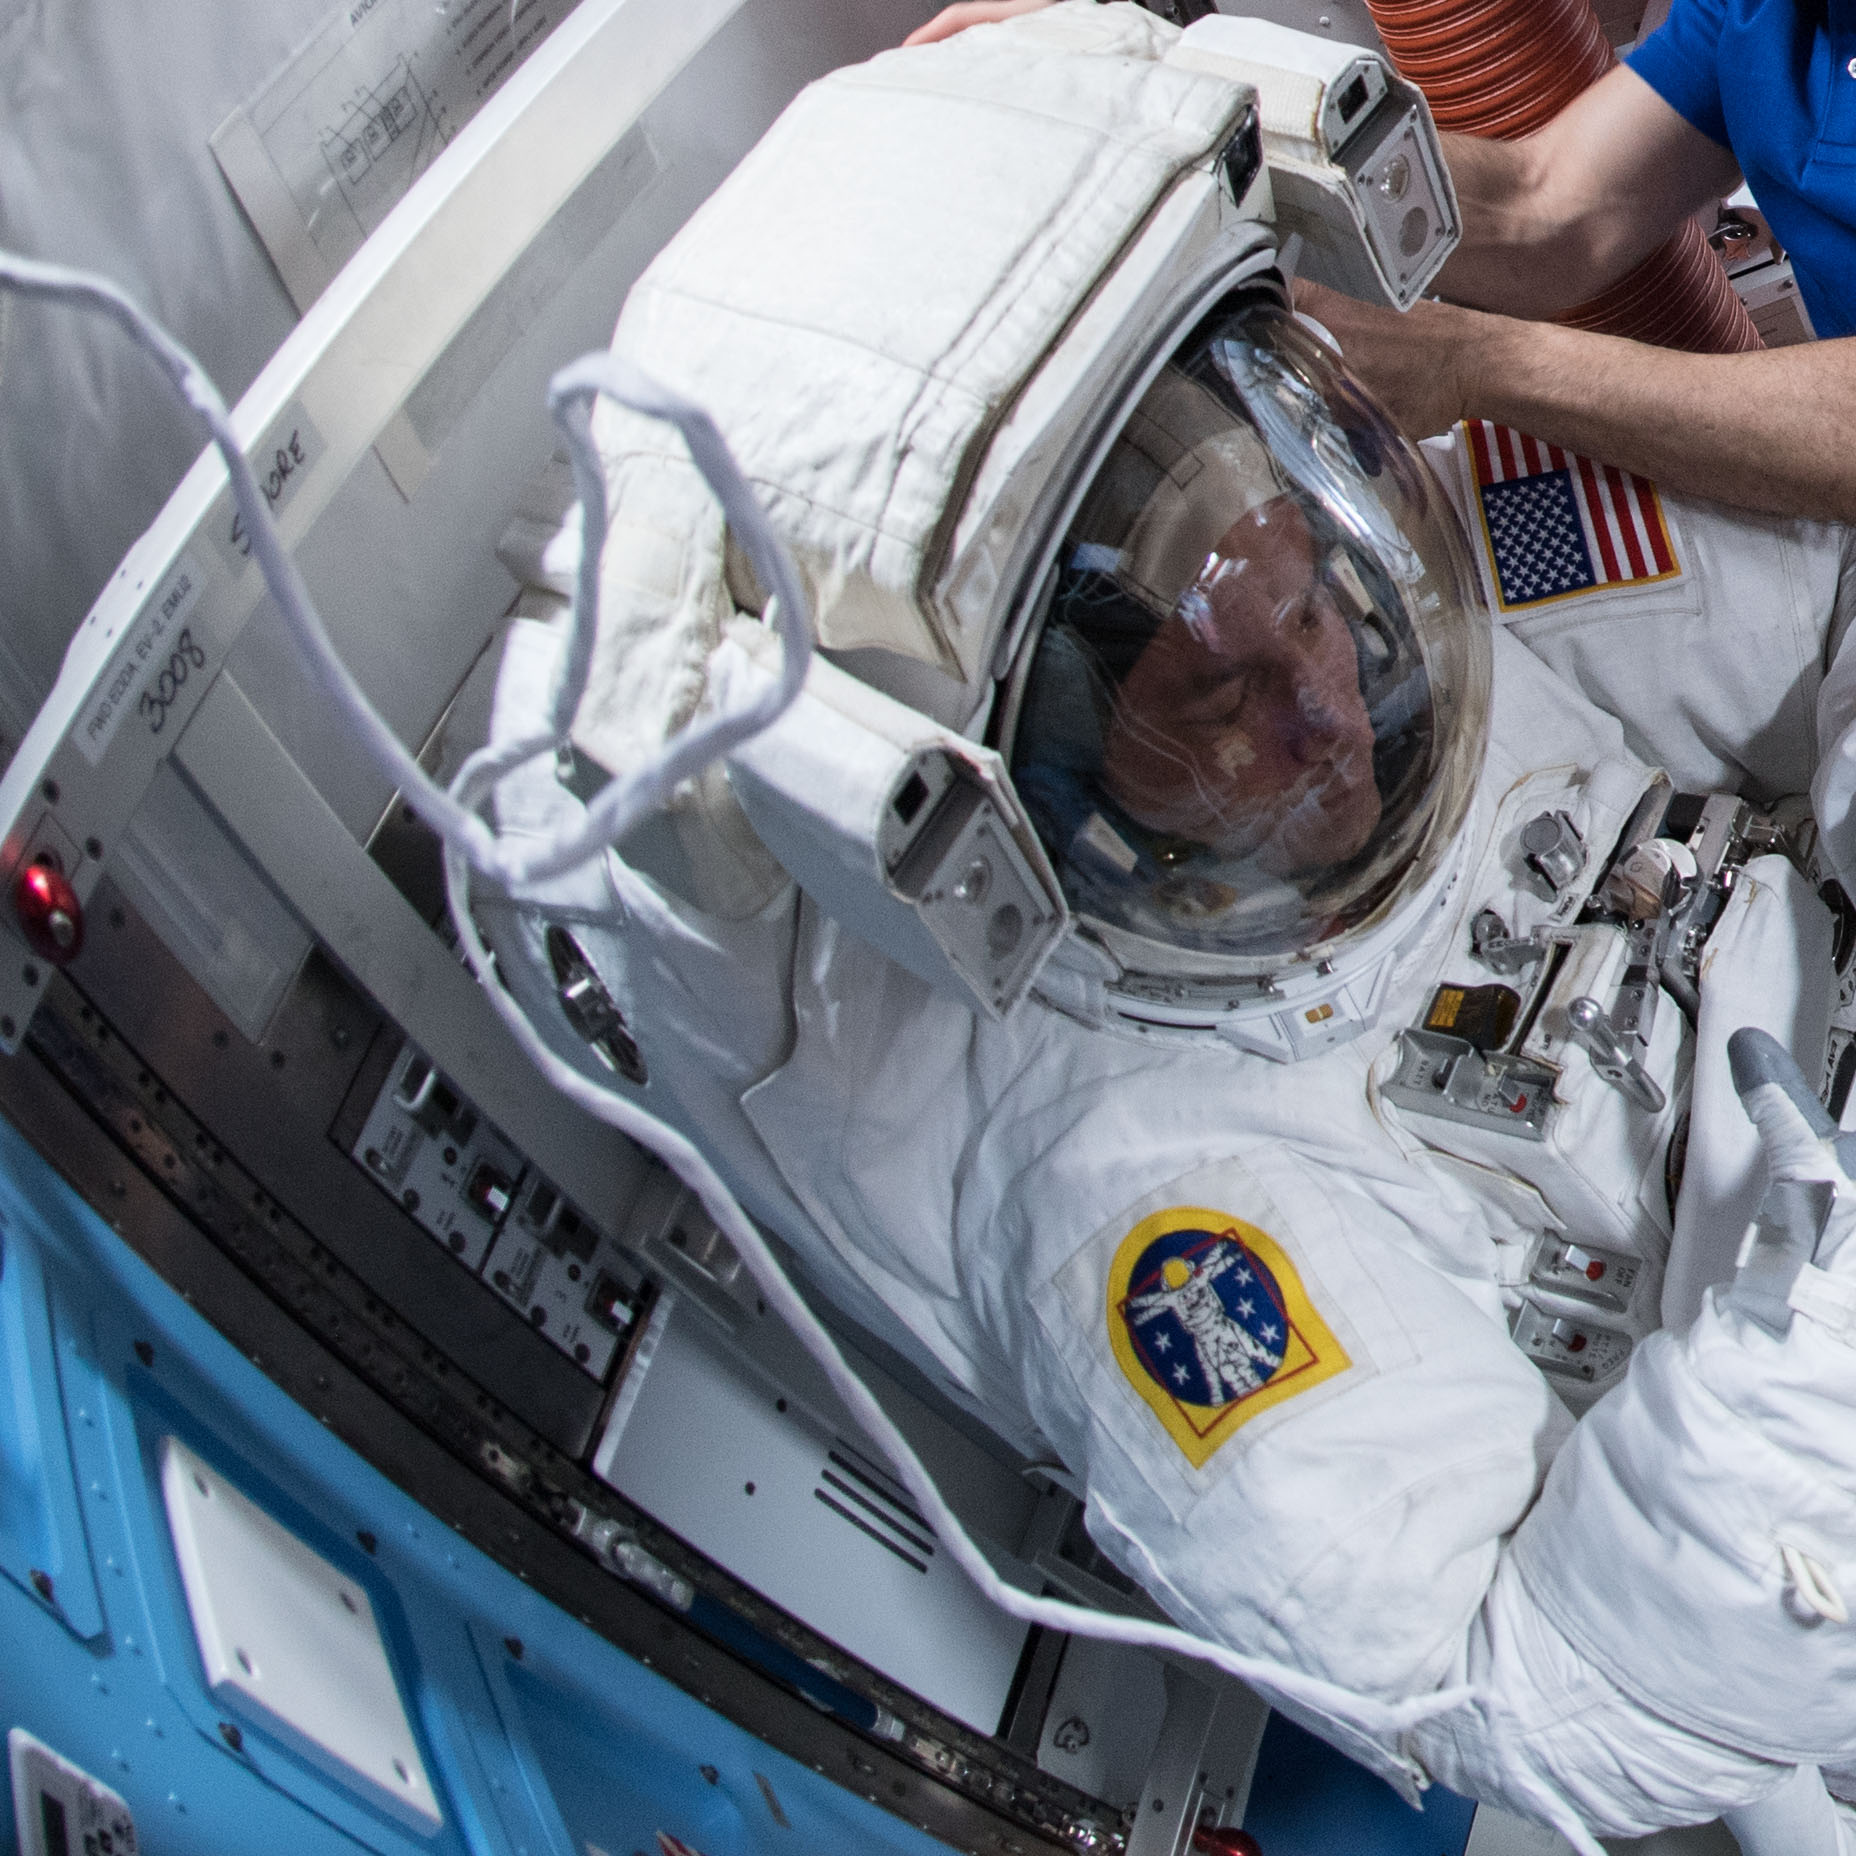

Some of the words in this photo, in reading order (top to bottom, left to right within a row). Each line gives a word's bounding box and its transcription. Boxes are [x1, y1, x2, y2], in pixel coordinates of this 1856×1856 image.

[139, 627, 206, 735] 3008
[1613, 1266, 1626, 1285] OFF
[1621, 1267, 1635, 1288] FAN
